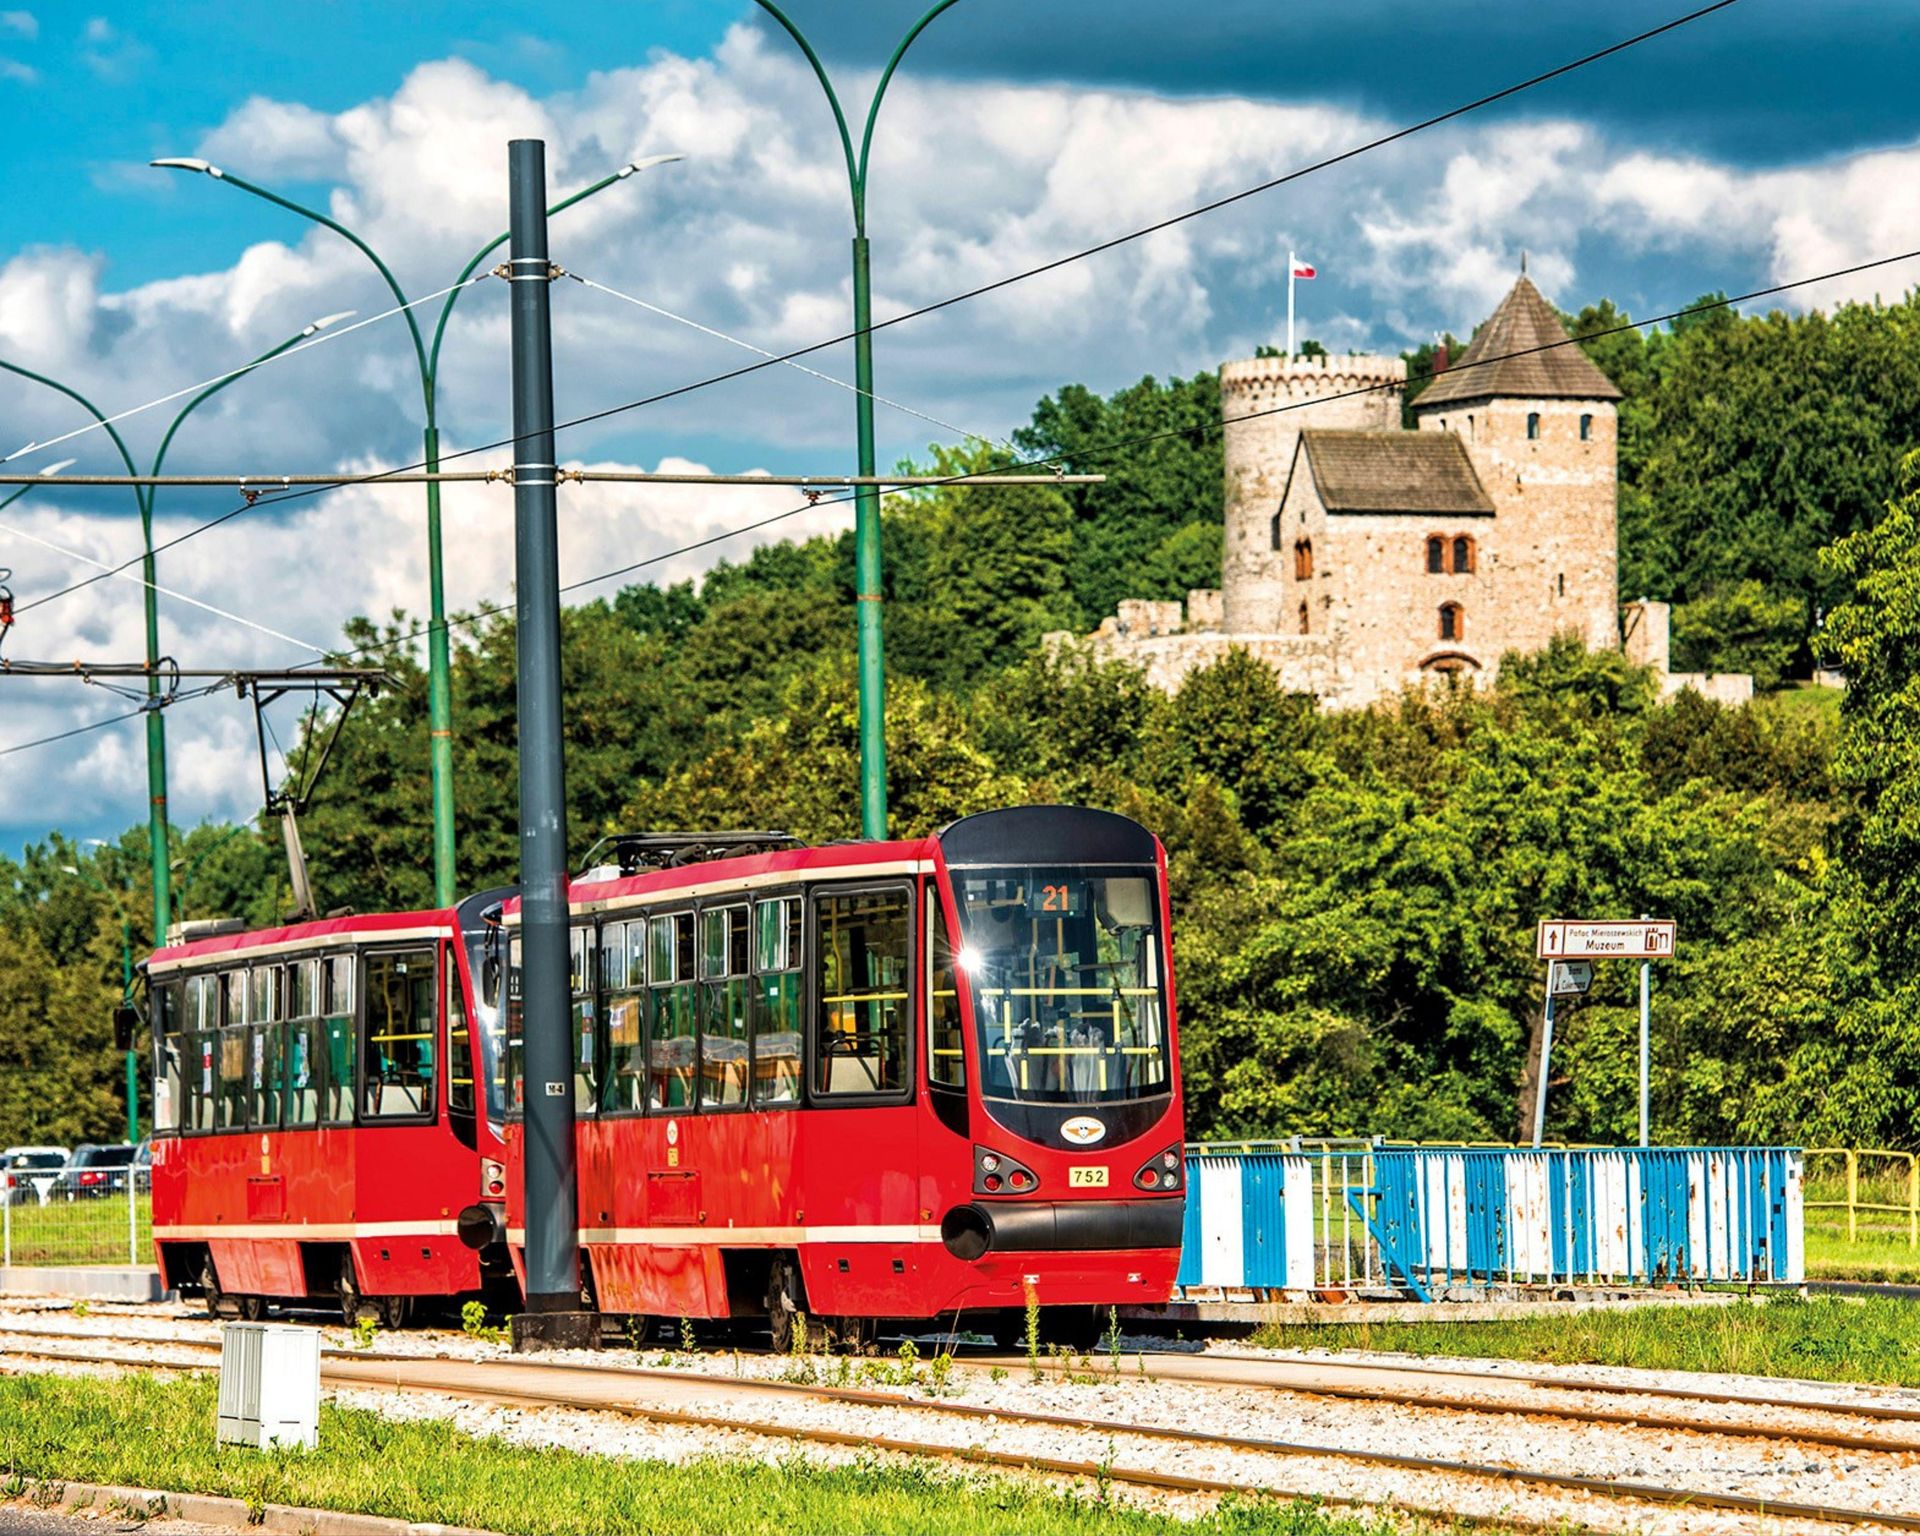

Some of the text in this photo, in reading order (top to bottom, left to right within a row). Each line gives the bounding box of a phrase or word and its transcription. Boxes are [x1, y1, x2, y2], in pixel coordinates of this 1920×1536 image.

[1042, 885, 1069, 911] 21
[1585, 939, 1625, 951] Muzeum
[1074, 1170, 1104, 1183] 752
